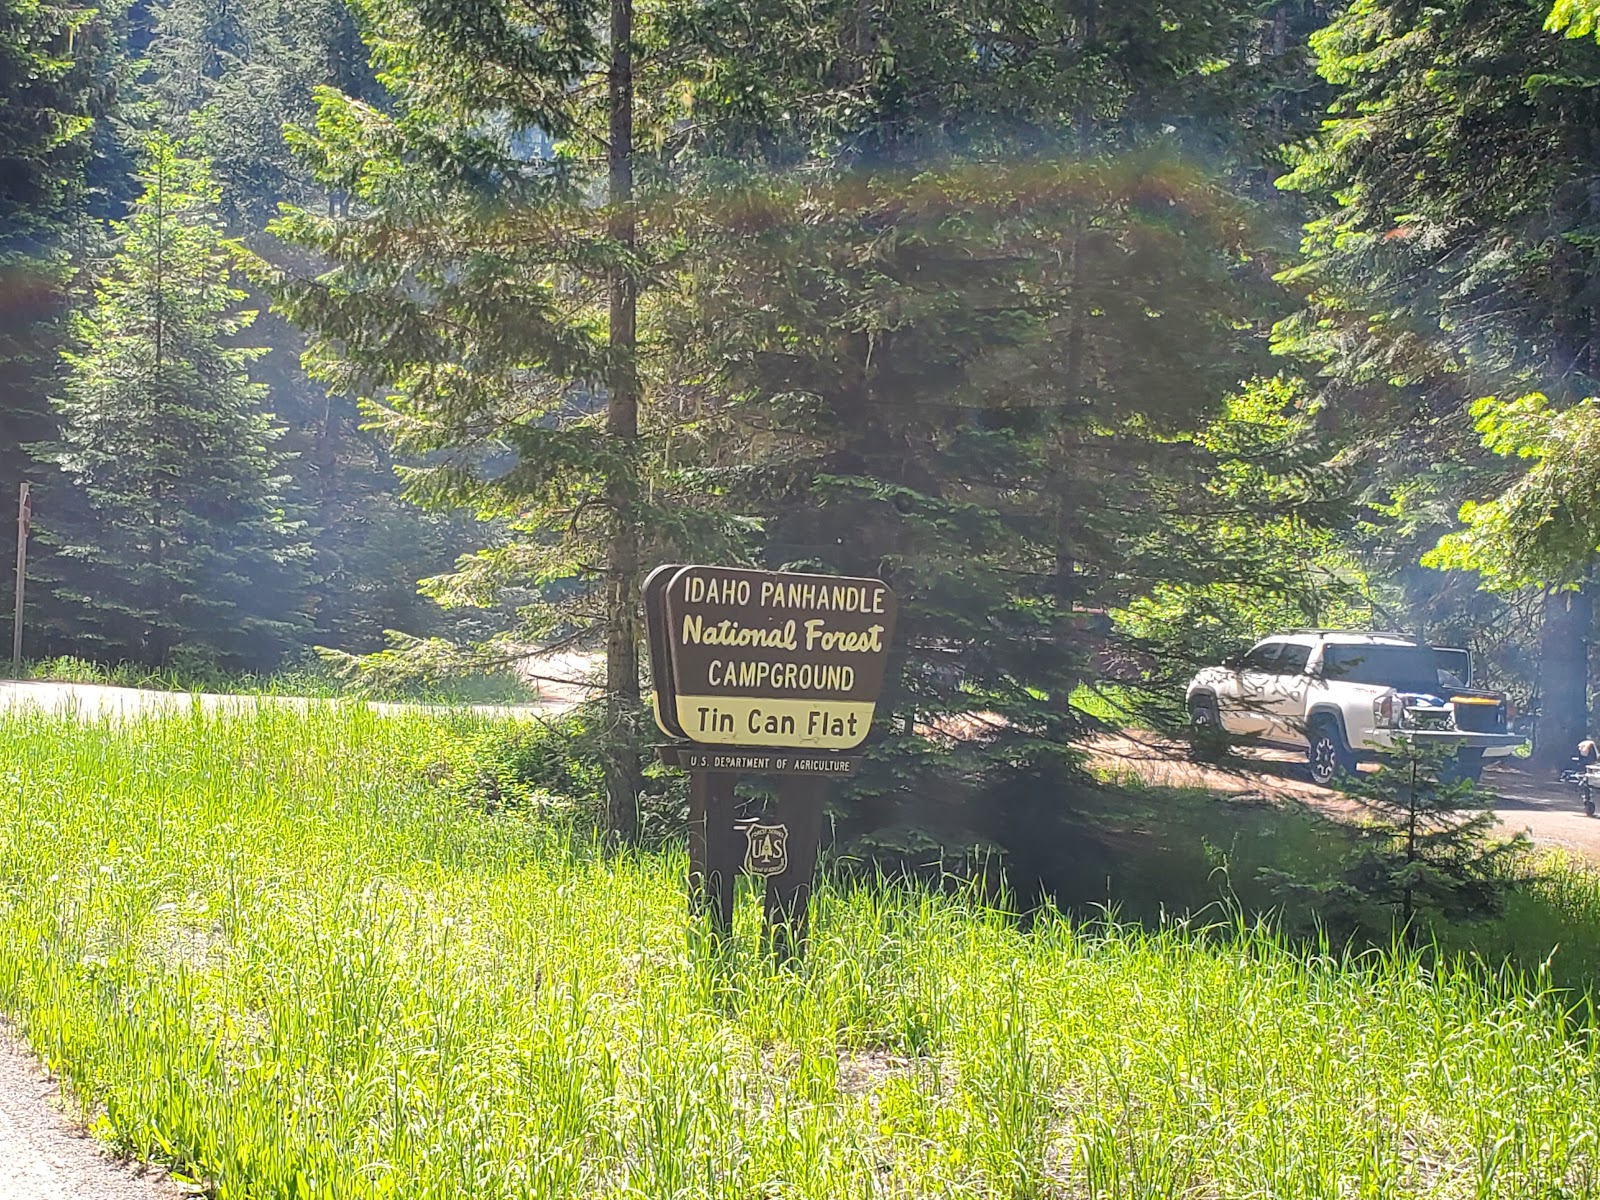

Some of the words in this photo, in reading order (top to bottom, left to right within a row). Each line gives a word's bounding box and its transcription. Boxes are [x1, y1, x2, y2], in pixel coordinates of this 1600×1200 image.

[684, 576, 750, 605] IDAHO
[760, 582, 885, 613] PANHANDLE
[682, 614, 797, 650] National
[803, 619, 884, 653] Forest
[708, 659, 855, 691] CAMPGROUND
[698, 707, 734, 732] Tin
[748, 709, 795, 734] Can
[808, 711, 857, 736] Flat
[714, 756, 770, 769] DEPARTMENT
[776, 758, 788, 770] OF
[794, 759, 850, 772] AGRICULTURE
